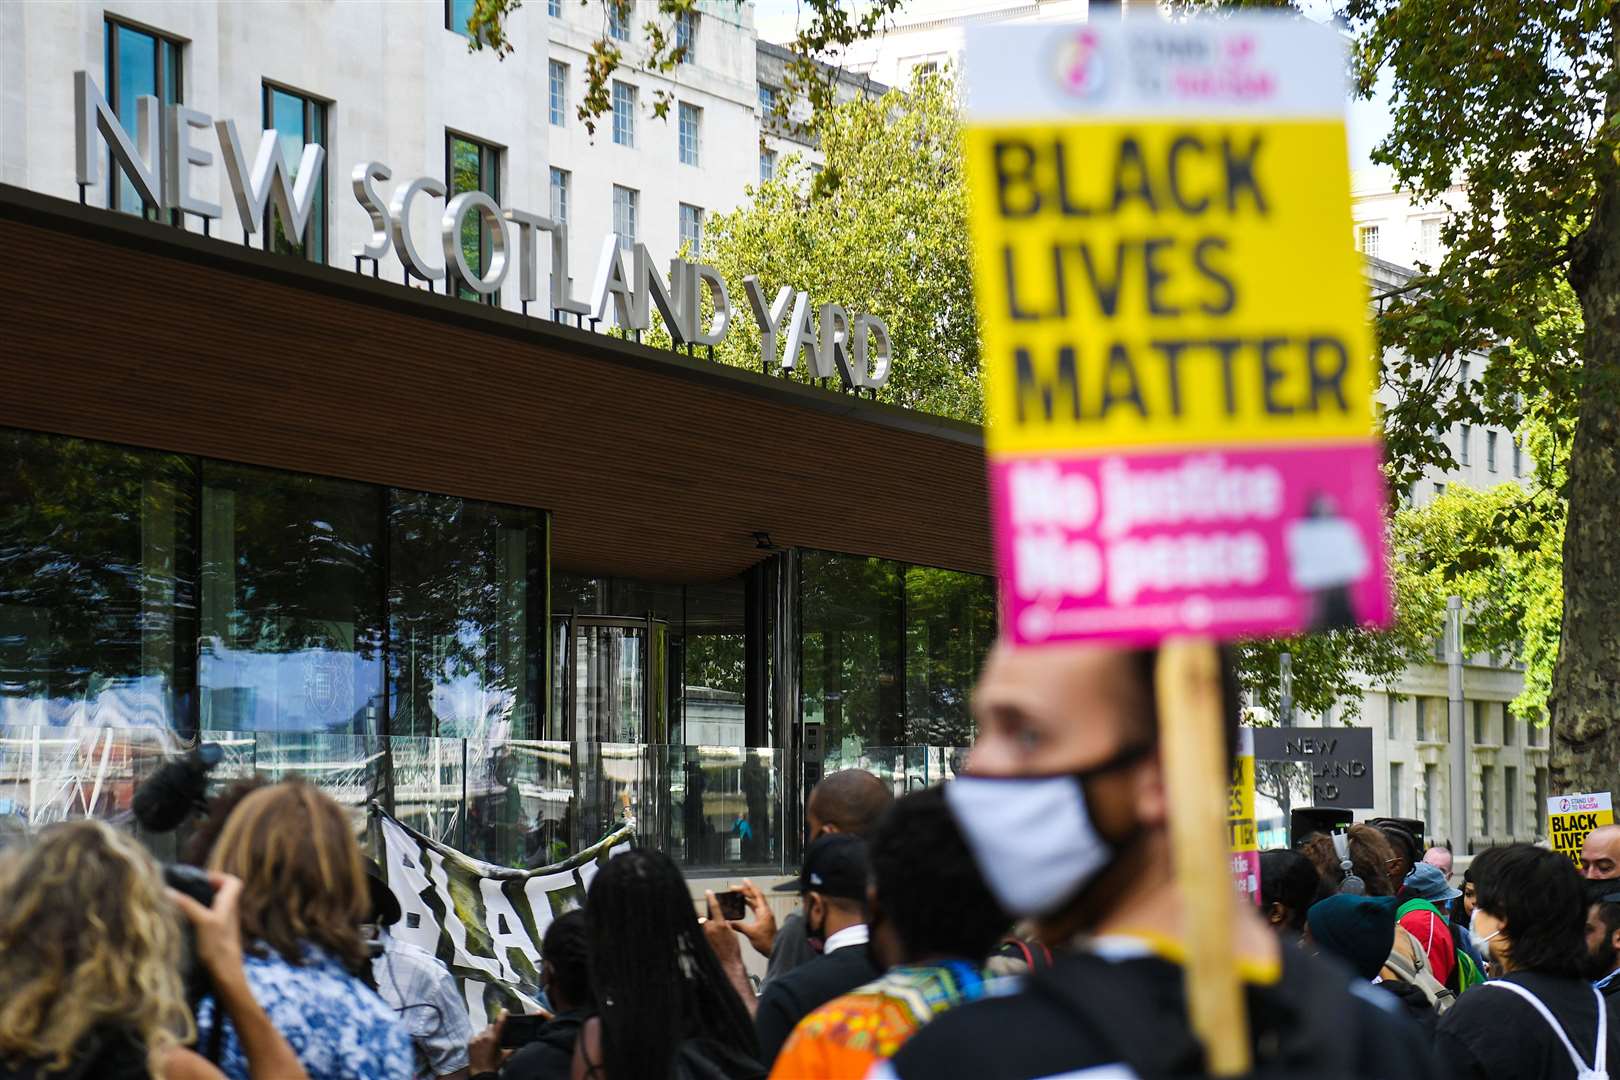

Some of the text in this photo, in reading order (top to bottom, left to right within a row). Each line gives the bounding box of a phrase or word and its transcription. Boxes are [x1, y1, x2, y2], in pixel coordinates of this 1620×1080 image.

[992, 133, 1268, 218] BLACK
[74, 70, 892, 388] NEW SCOTLAND YARD
[1004, 237, 1238, 321] LIVES
[1013, 336, 1350, 424] MATTER
[1286, 736, 1337, 755] NEW
[1552, 813, 1598, 832] BLACK
